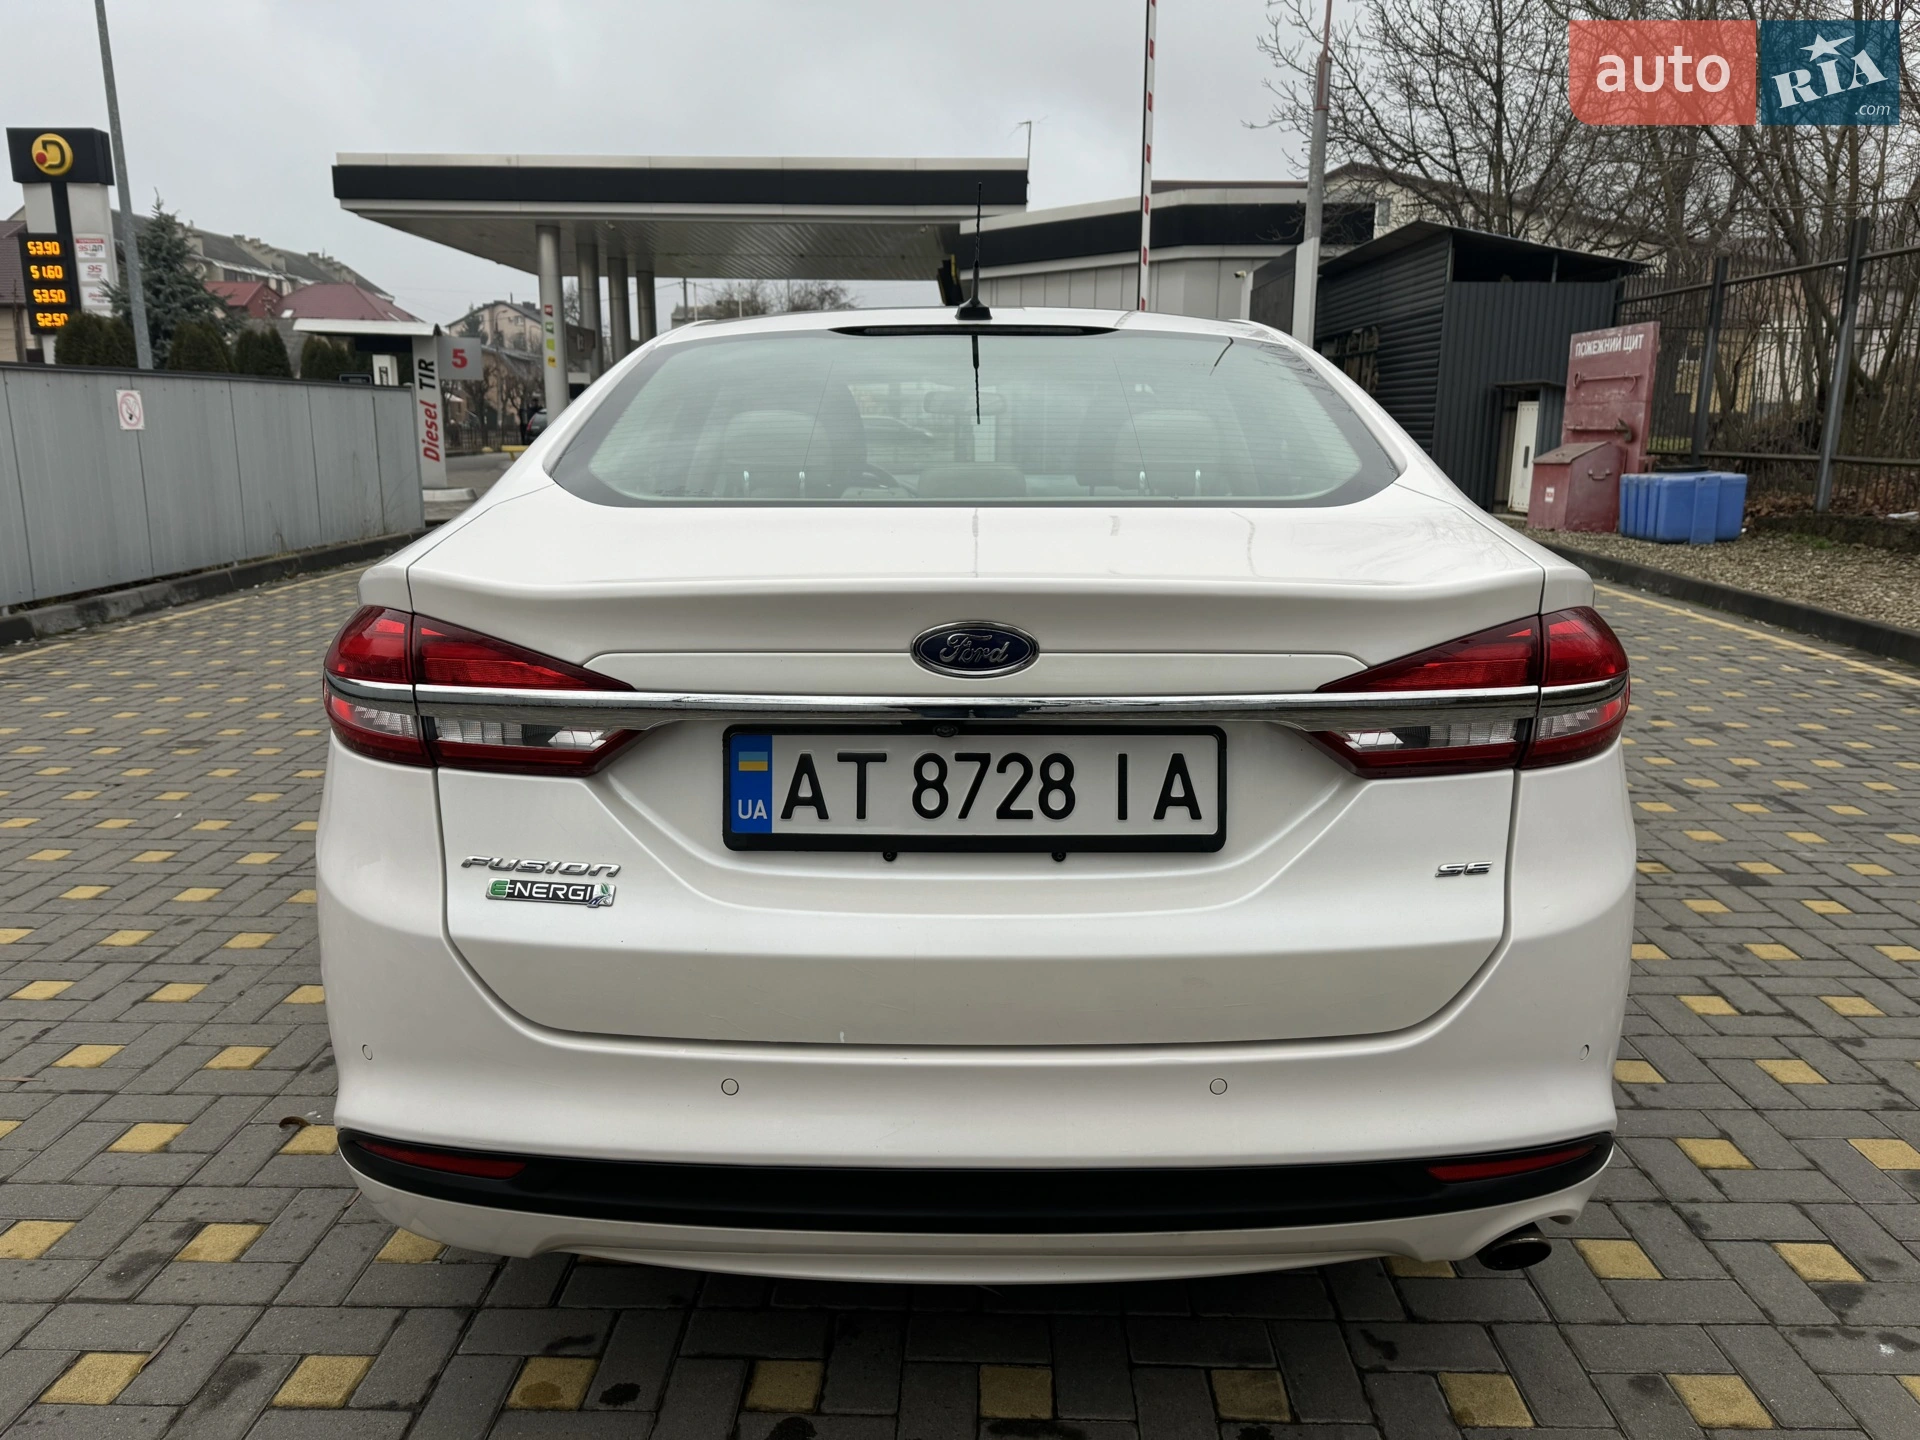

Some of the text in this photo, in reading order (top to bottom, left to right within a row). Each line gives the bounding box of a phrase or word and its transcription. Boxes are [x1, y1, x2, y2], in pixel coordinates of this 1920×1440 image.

[27, 241, 61, 255] 53.90
[33, 289, 67, 303] 53.50
[1575, 333, 1645, 357] ПОЖЕЖНИЙ ЩИТ
[452, 348, 468, 369] 5
[418, 358, 441, 462] Diesel TIR
[939, 633, 1011, 663] Ford
[780, 752, 1203, 820] AT 8728 IA
[737, 799, 768, 820] UA
[460, 855, 622, 878] FUSION
[1435, 861, 1493, 878] SE
[489, 879, 592, 901] ENERGI
